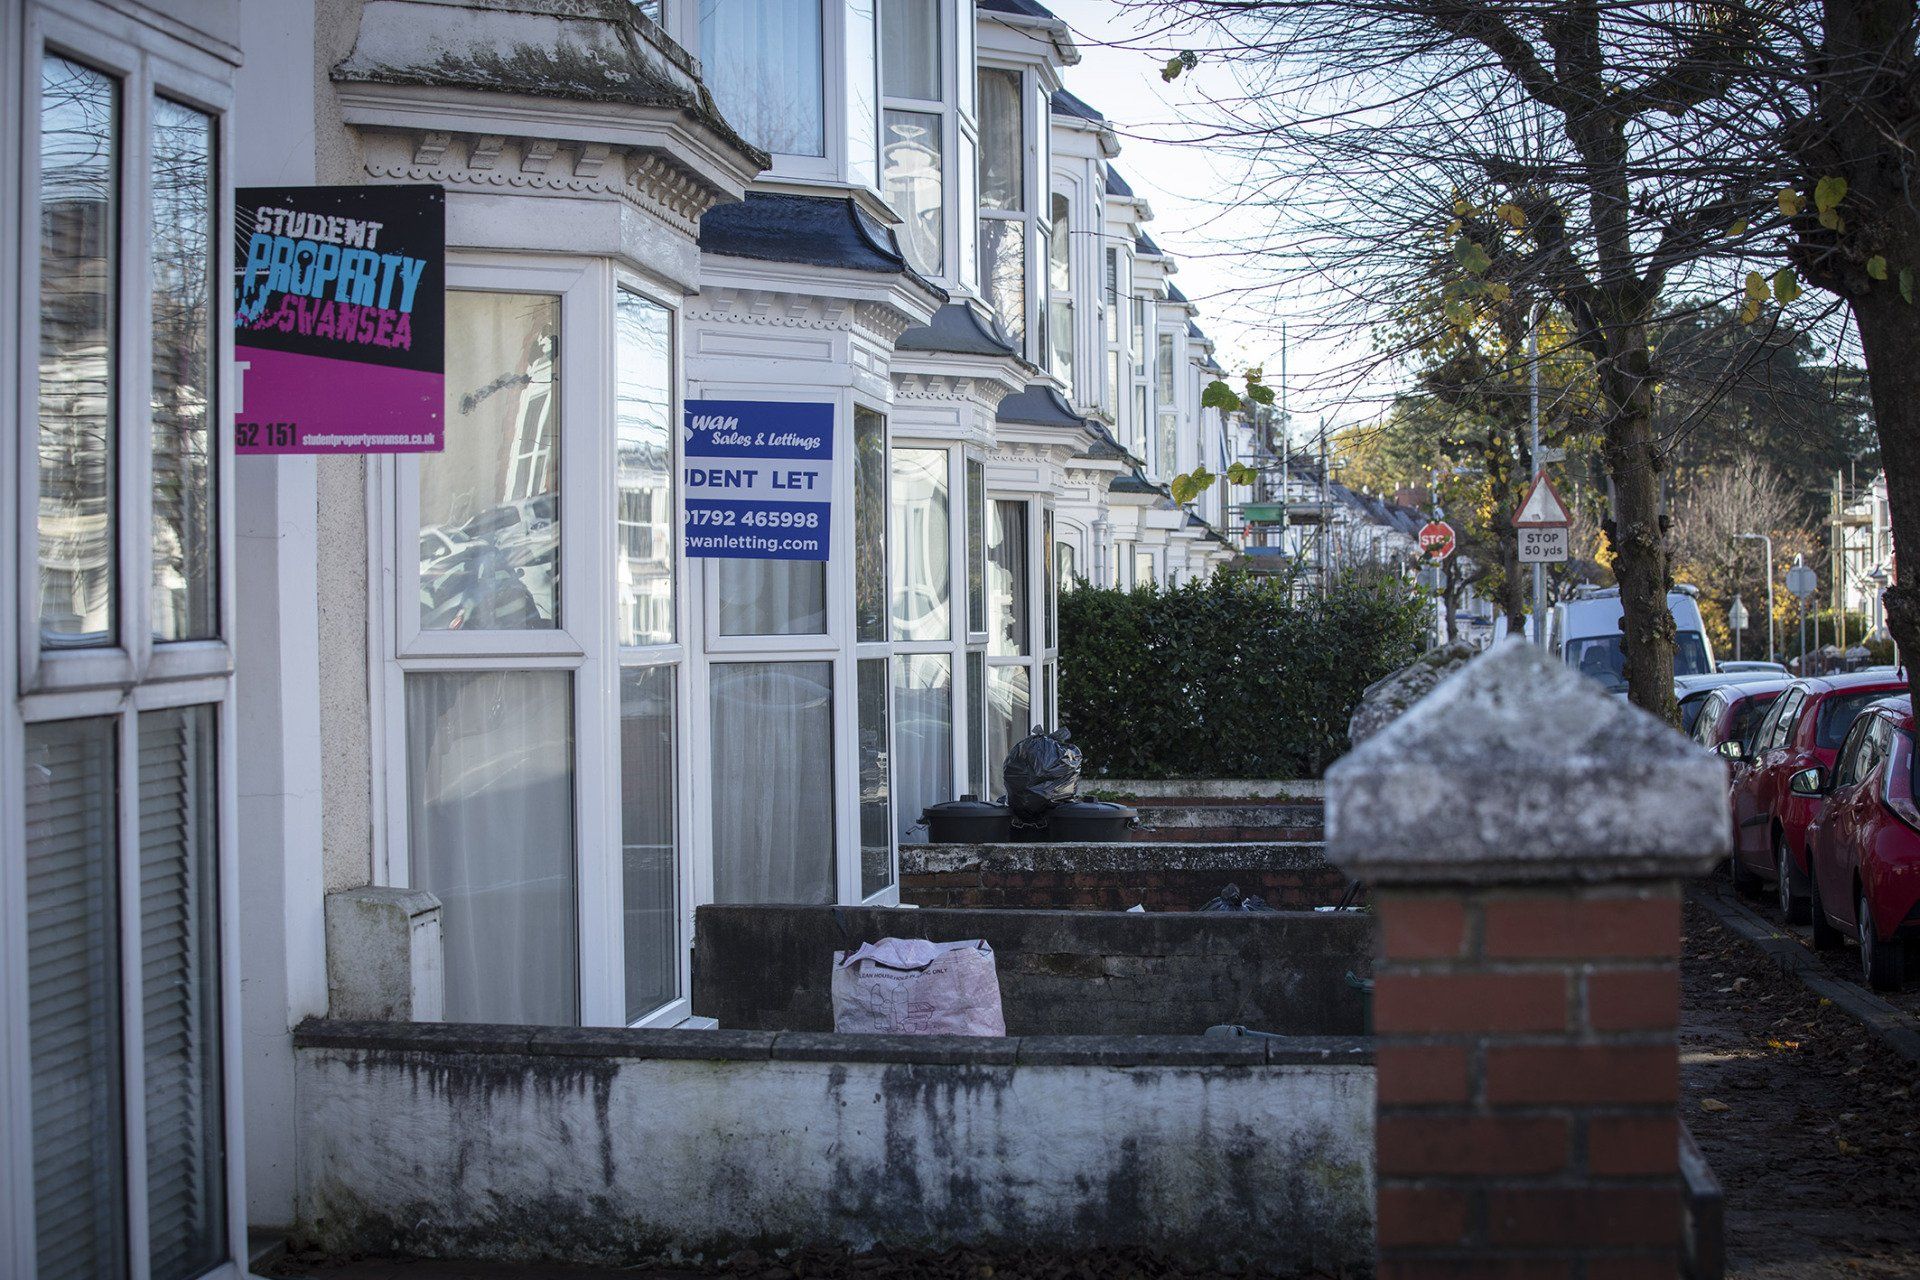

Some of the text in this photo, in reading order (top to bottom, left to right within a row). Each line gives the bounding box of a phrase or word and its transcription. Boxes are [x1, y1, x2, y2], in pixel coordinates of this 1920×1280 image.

[256, 206, 383, 250] STUDENT
[247, 232, 427, 313] PROPERTY
[279, 294, 413, 350] SWANSEA
[266, 423, 297, 446] 151
[302, 432, 435, 448] studentpropertyswansea.co.uk
[711, 431, 821, 451] Sales & Lettings
[772, 470, 819, 490] LET
[740, 511, 819, 528] 465998
[1527, 533, 1559, 544] STOP
[1525, 545, 1563, 558] 50 yds
[932, 967, 948, 975] ONLY
